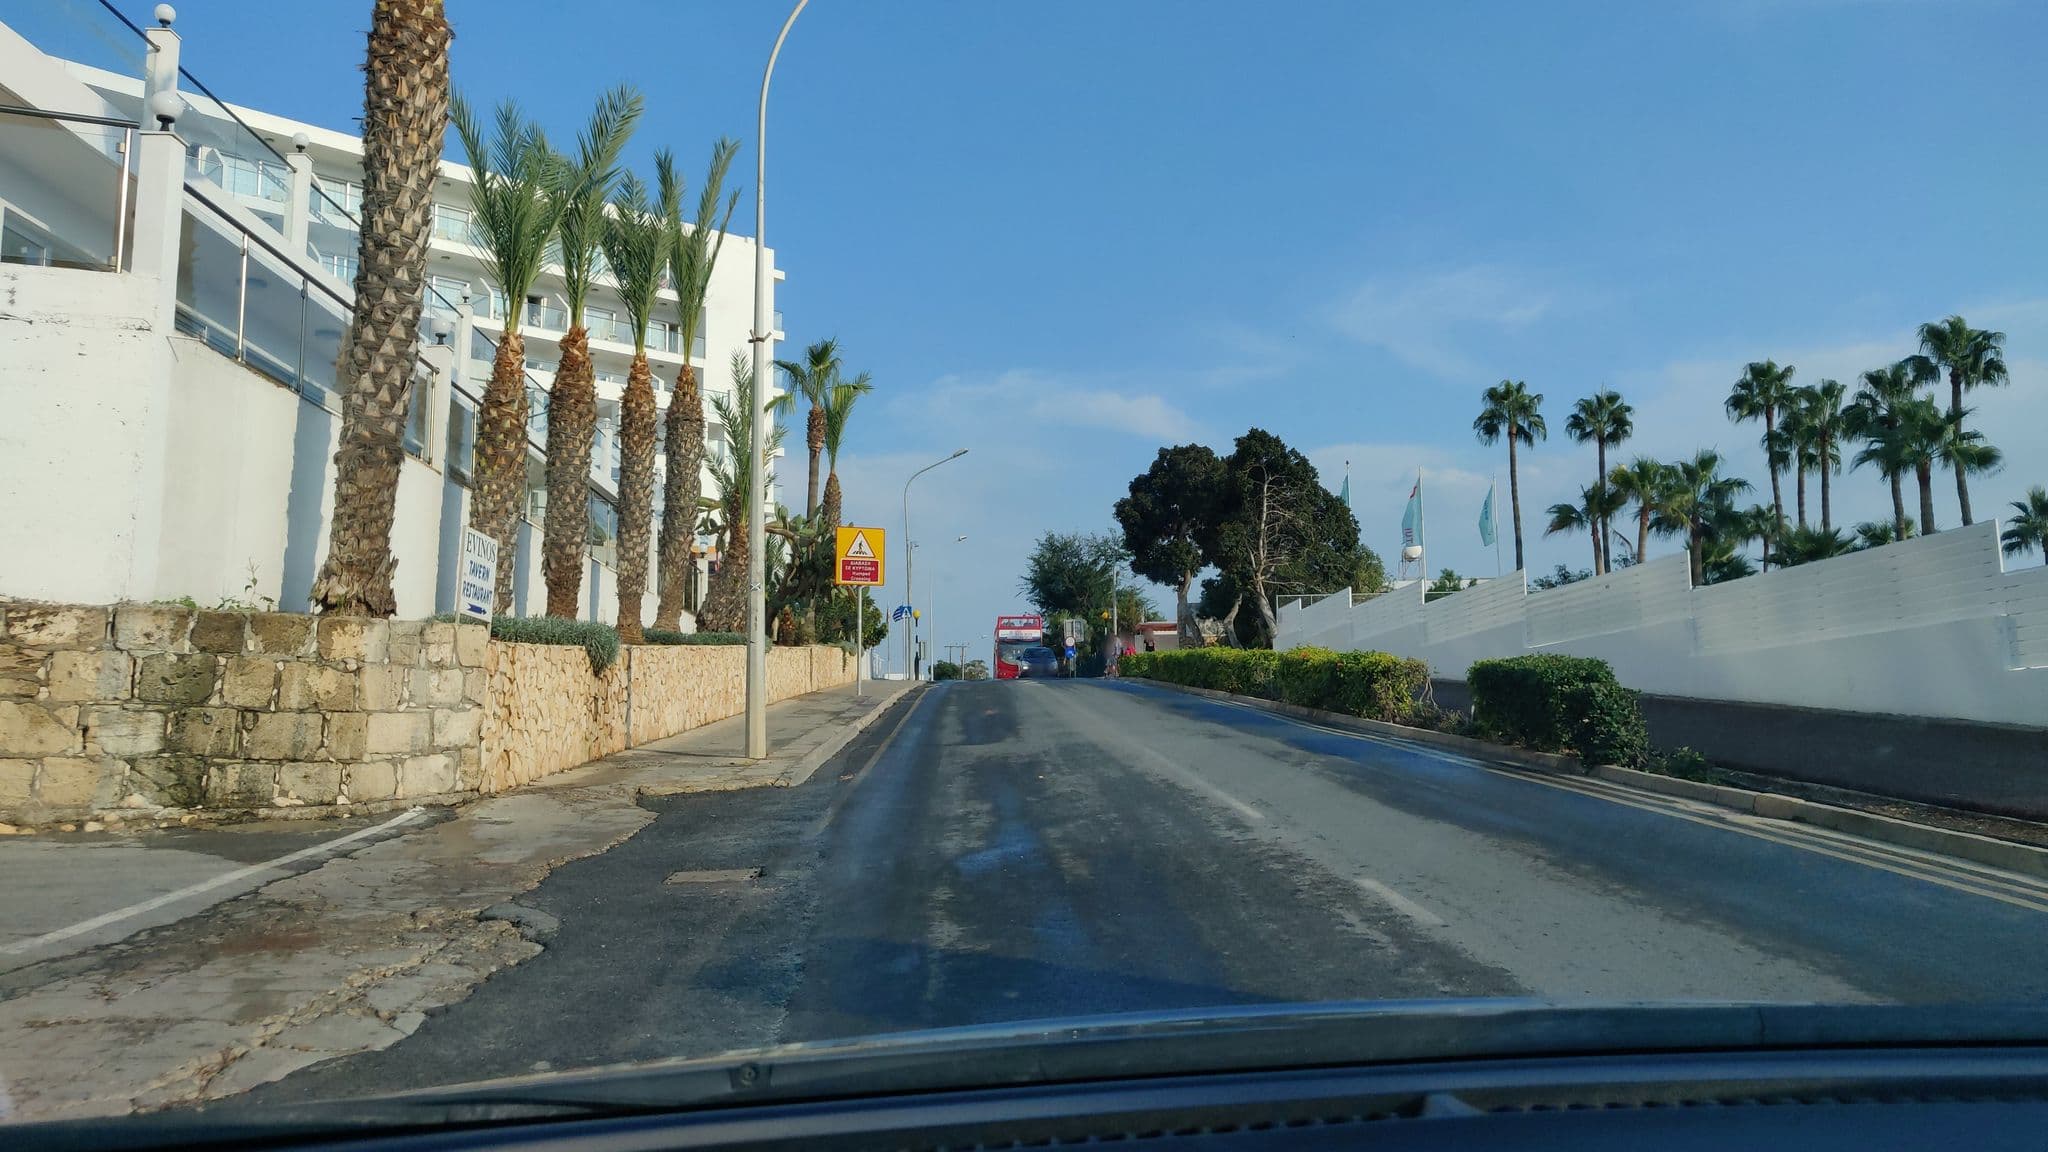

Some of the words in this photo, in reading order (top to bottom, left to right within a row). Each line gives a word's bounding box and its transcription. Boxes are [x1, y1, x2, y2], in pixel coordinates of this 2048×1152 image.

[466, 532, 496, 563] EVINOS
[469, 560, 490, 582] TAVERN
[462, 581, 492, 604] RESTAURANT
